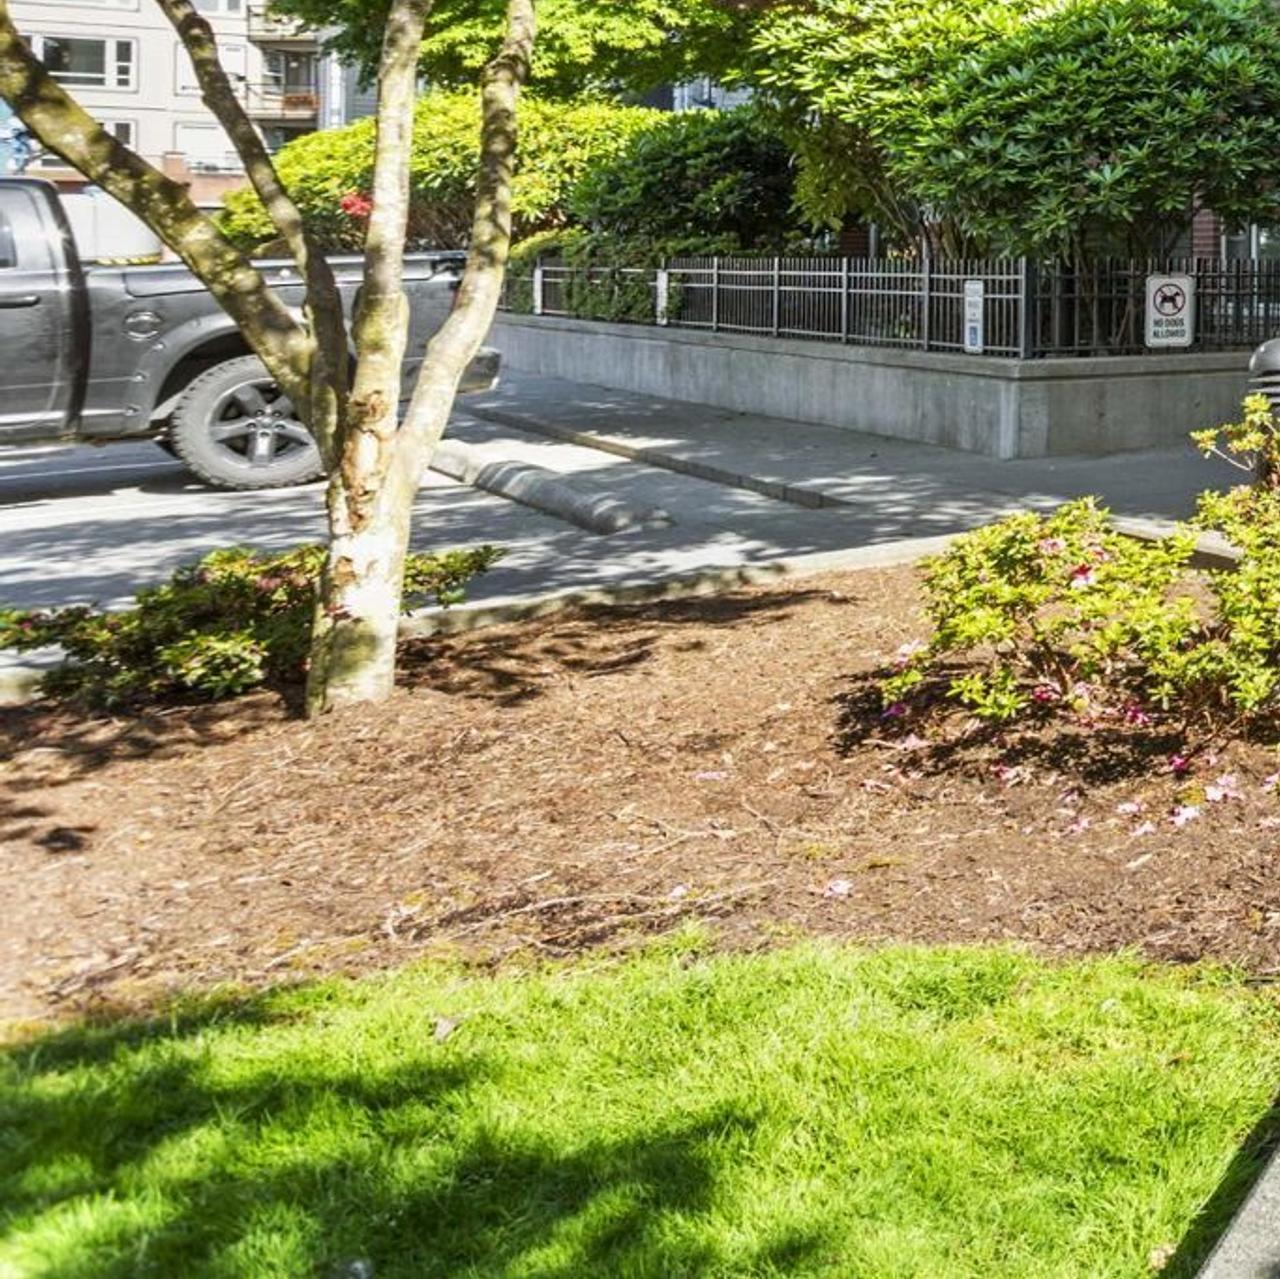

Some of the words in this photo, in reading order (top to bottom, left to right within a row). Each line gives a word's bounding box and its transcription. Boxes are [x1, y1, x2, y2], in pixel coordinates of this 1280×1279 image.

[1153, 318, 1163, 327] NO
[1164, 318, 1185, 327] DOGS
[1153, 329, 1186, 338] ALLOWED
